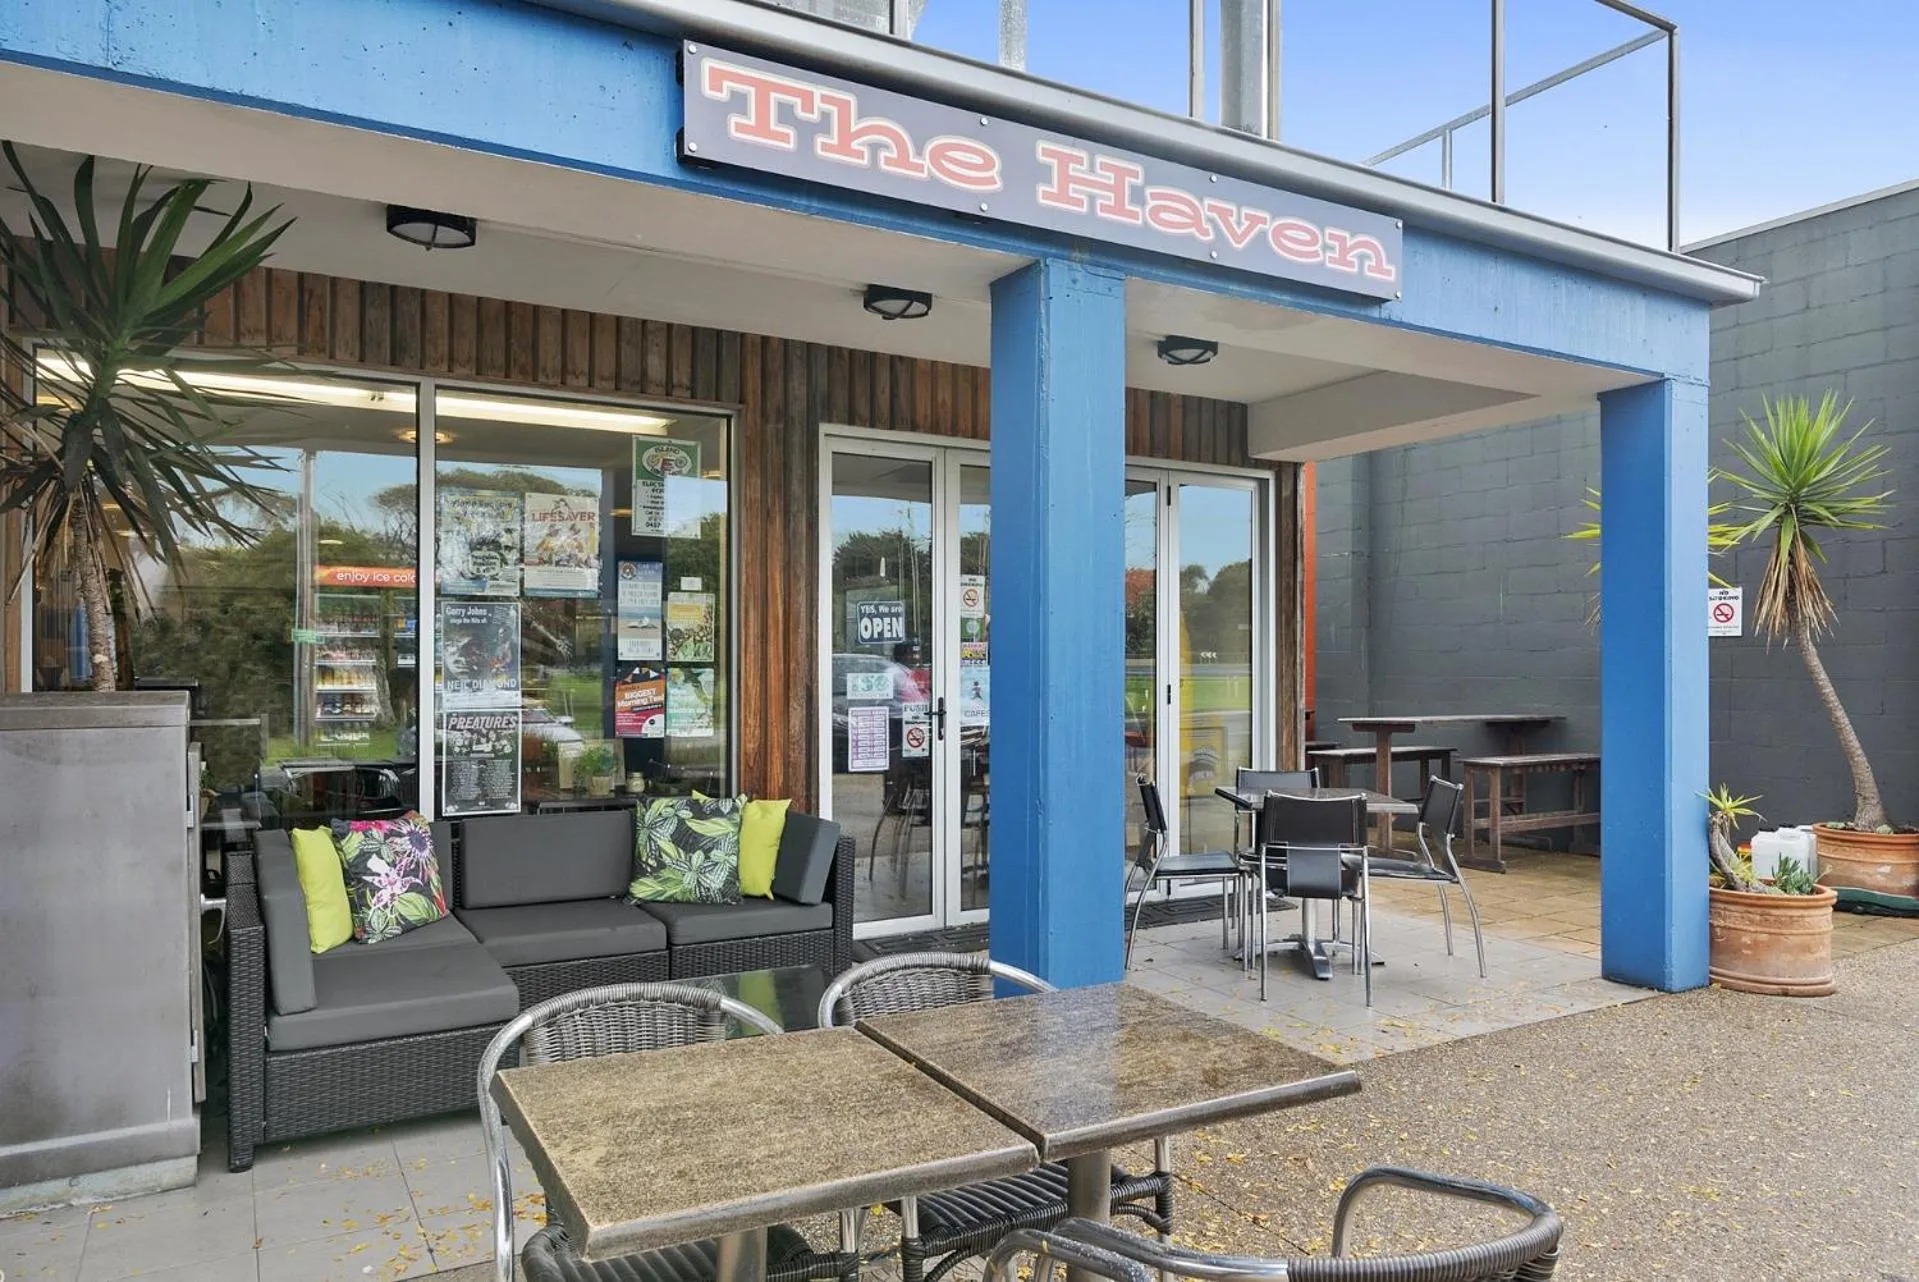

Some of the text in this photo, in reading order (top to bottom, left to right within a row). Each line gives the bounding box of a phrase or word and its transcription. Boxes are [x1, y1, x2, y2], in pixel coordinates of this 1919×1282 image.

[702, 58, 1394, 281] The Haven
[531, 511, 596, 523] LIFESAVER
[336, 571, 369, 583] enjoy
[372, 571, 391, 582] ice
[860, 604, 878, 615] YES,
[860, 616, 904, 640] OPEN
[903, 704, 929, 712] PUSH
[447, 715, 519, 730] PREATURES
